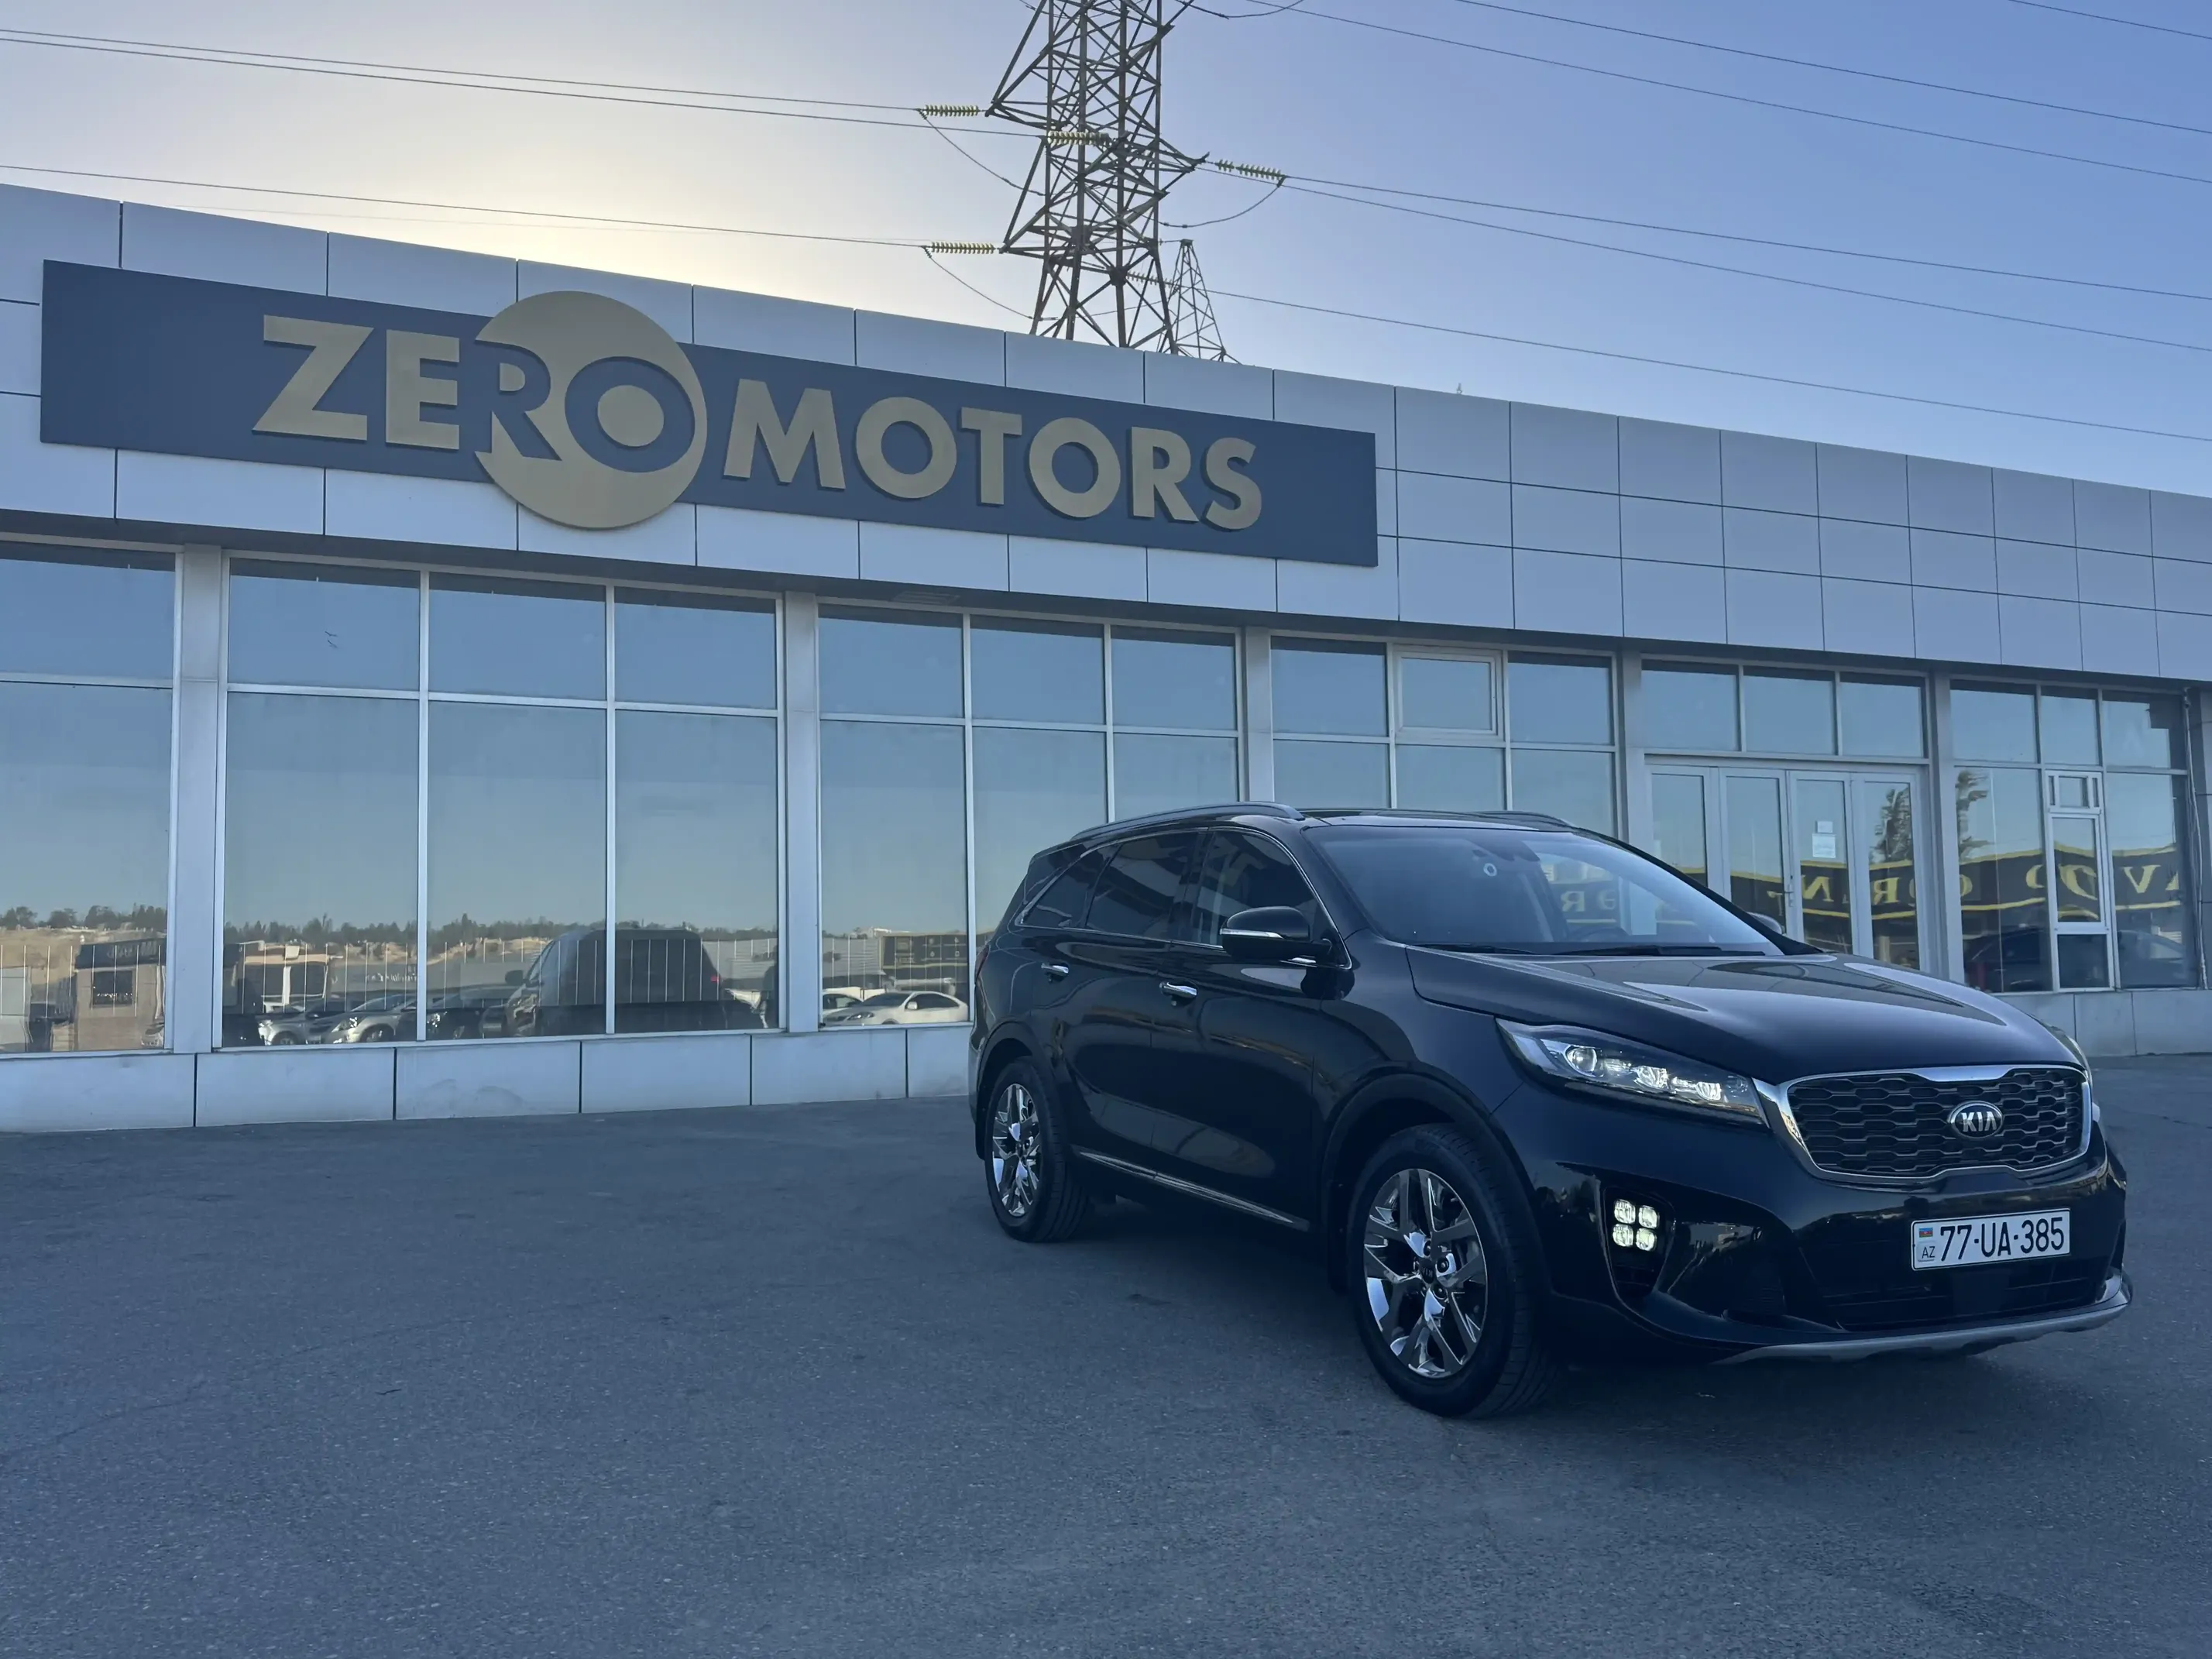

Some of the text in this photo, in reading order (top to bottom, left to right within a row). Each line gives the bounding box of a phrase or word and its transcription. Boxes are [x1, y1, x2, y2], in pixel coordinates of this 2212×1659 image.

[252, 314, 1263, 531] ZERO MOTORS
[1961, 1111, 1997, 1132] KIA
[1922, 1245, 1936, 1259] AZ
